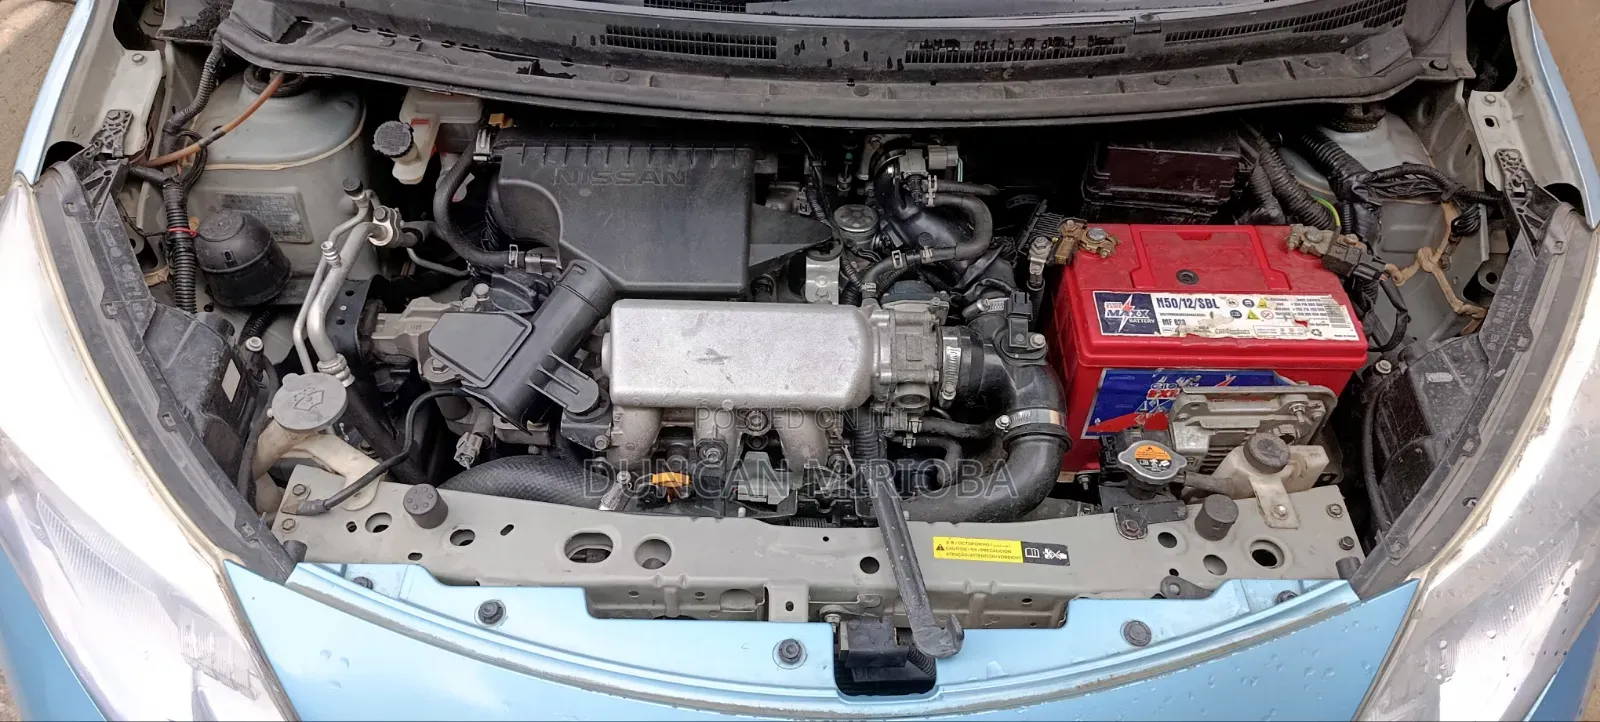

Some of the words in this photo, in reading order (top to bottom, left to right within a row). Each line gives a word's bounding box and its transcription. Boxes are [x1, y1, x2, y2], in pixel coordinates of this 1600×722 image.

[553, 168, 687, 187] NISSAN
[1156, 297, 1220, 310] N50/12/SBL
[1106, 309, 1150, 318] MAXX
[1162, 318, 1173, 326] MF
